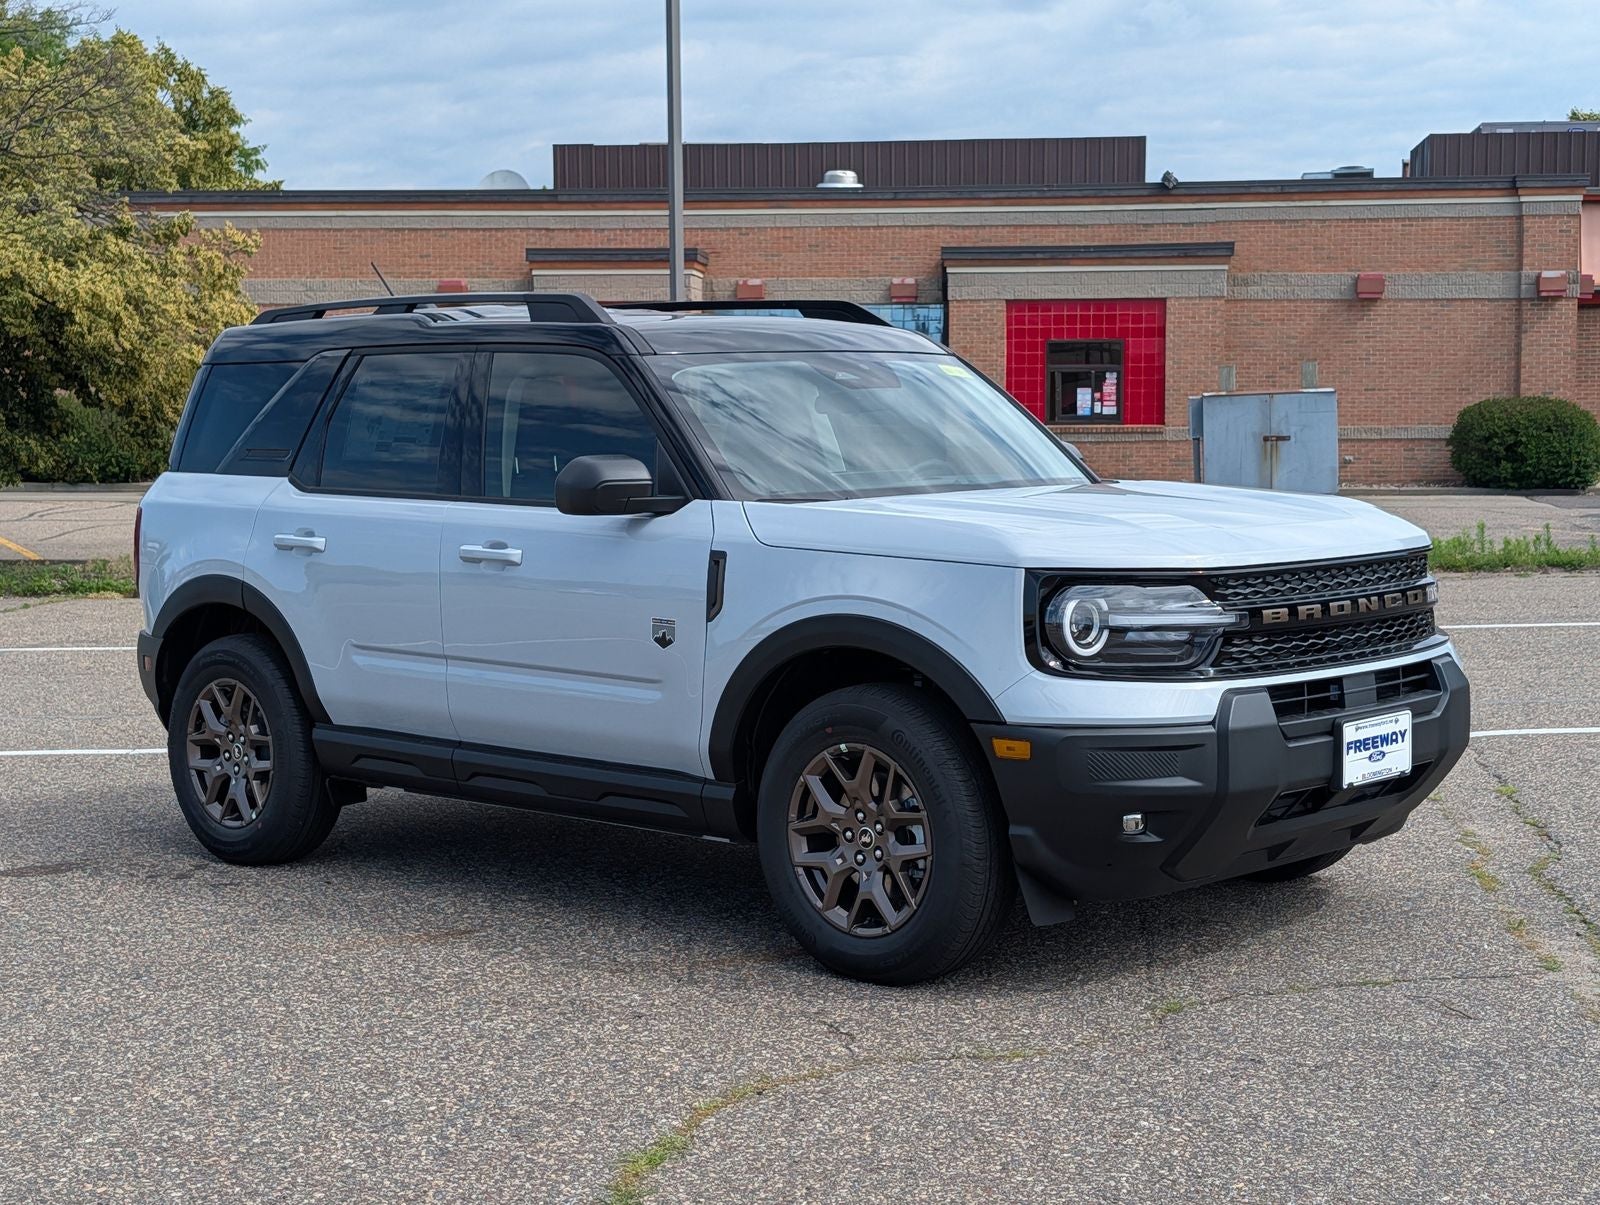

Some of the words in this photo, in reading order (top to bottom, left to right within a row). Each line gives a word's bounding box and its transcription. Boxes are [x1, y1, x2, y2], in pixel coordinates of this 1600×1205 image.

[1262, 589, 1424, 624] BRONCO
[1346, 729, 1408, 755] FREEWAY
[1370, 751, 1384, 762] Ford
